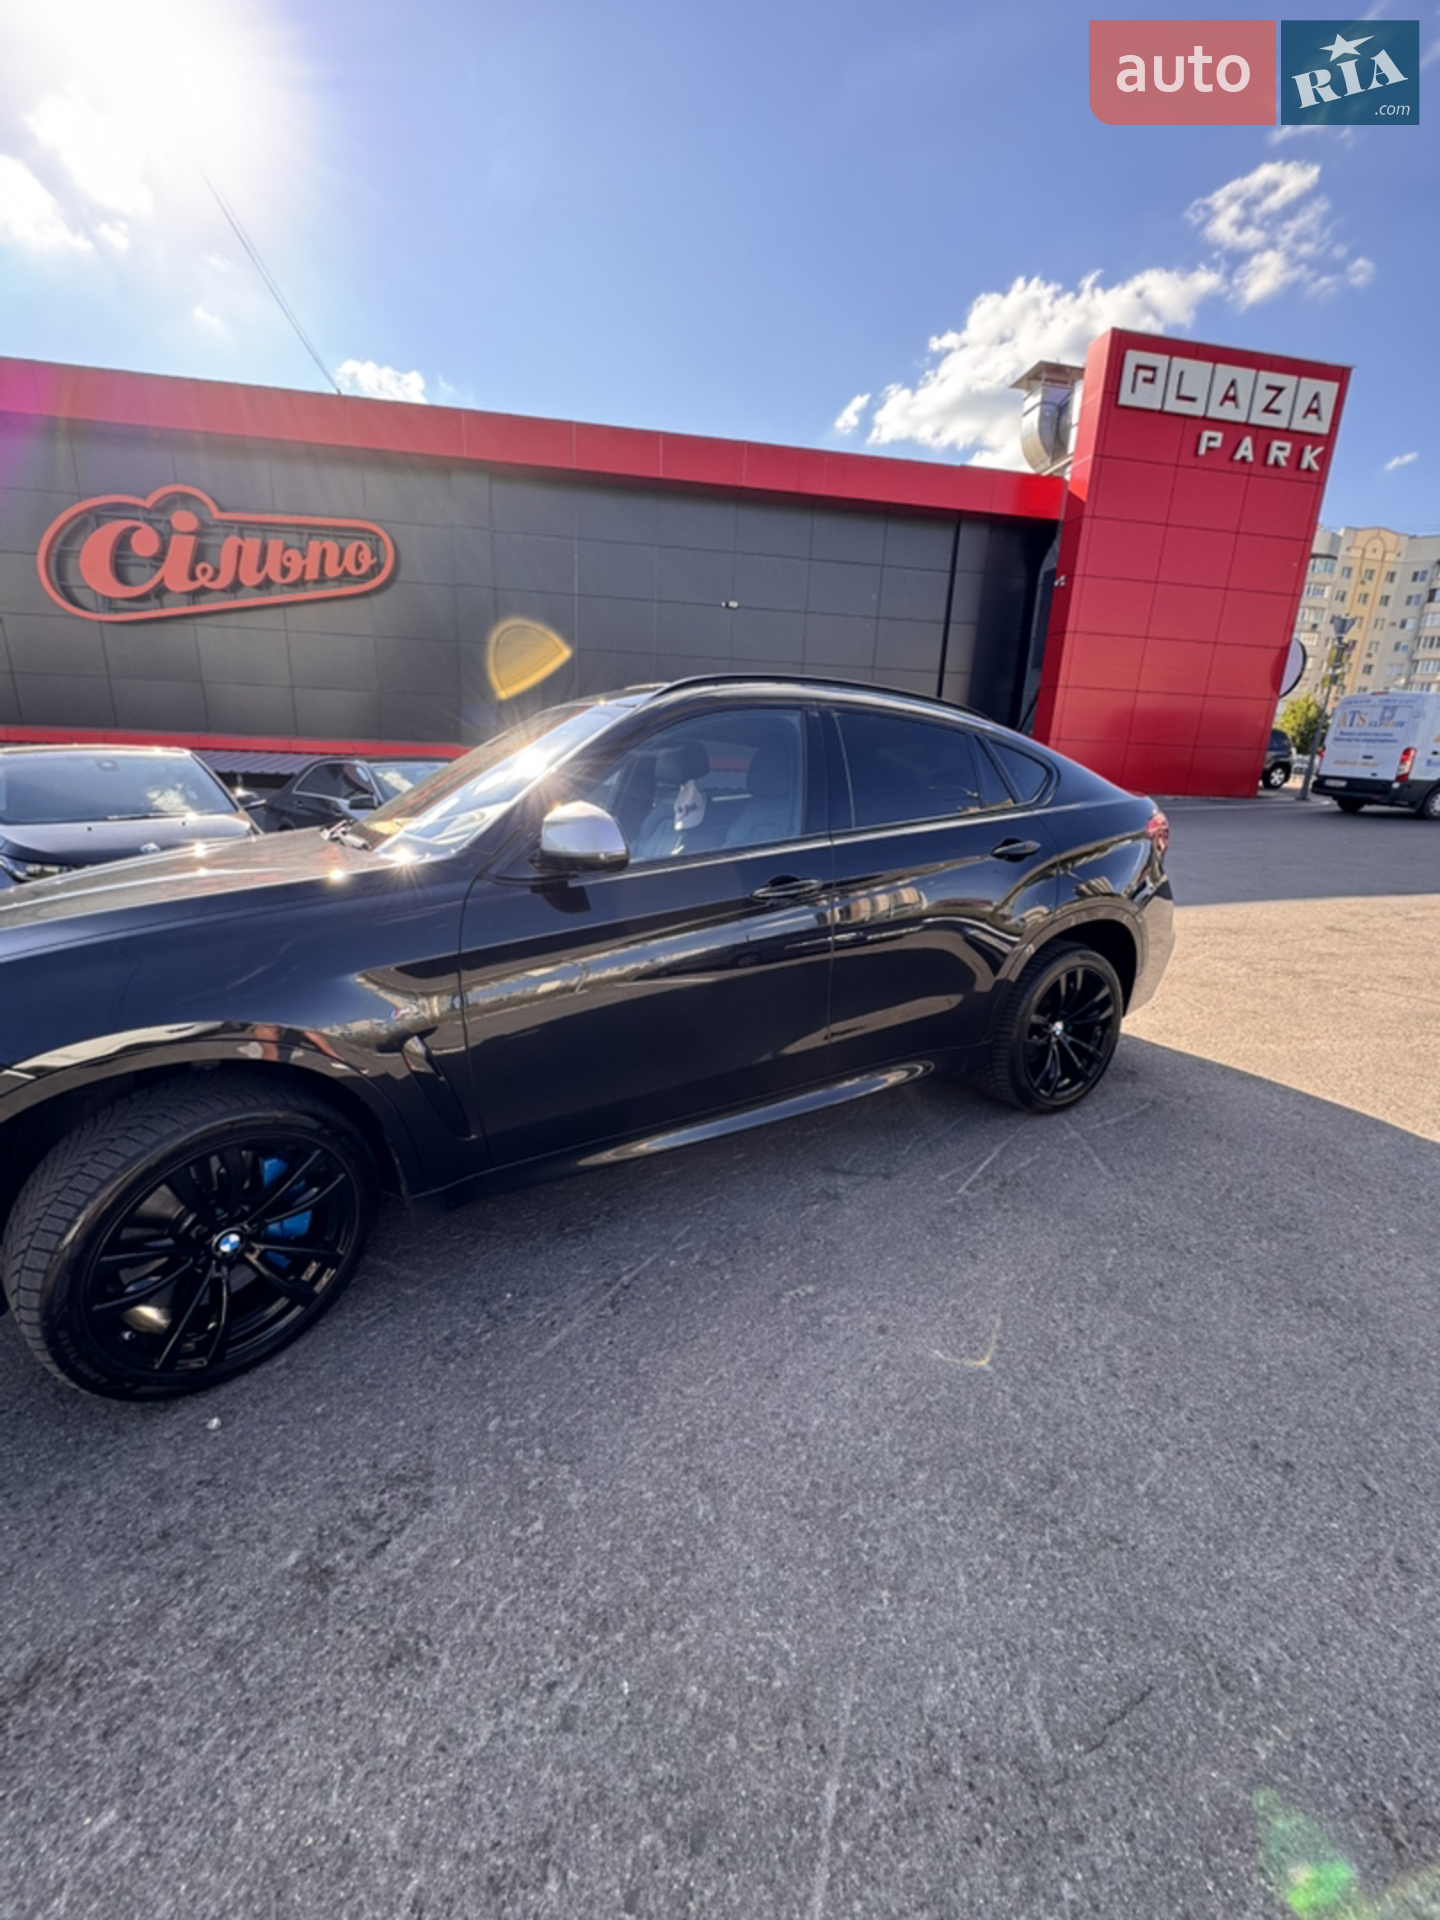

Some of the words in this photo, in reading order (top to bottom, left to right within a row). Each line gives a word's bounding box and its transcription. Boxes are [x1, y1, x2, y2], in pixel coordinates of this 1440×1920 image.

[1130, 363, 1323, 422] PLAZA
[1197, 430, 1325, 472] PARK
[79, 510, 377, 599] Сільпо
